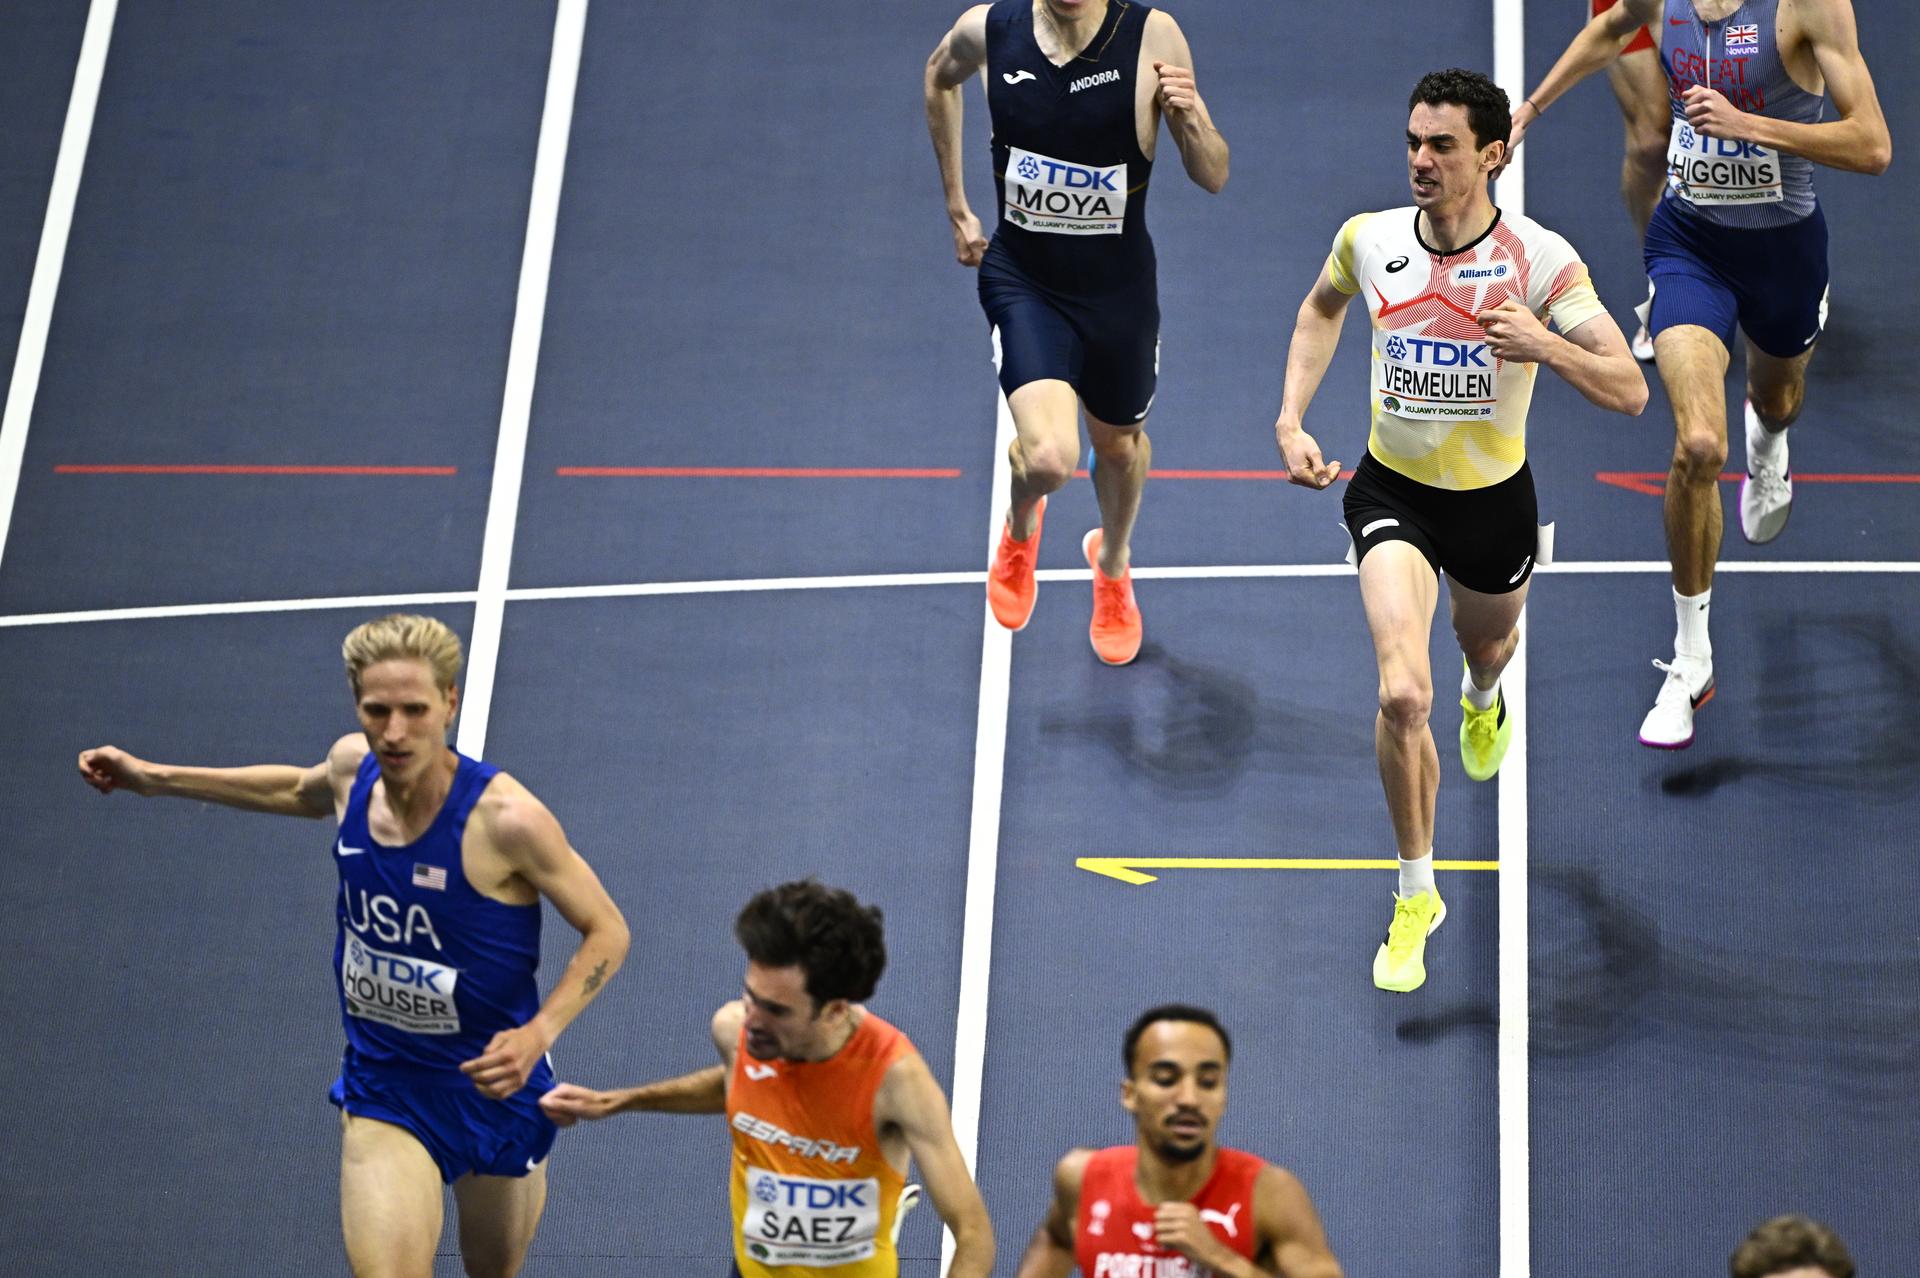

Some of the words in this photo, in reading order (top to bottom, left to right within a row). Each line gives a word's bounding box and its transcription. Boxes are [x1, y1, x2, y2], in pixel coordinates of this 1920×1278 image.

[1069, 69, 1121, 93] ANDORRA
[1671, 47, 1750, 85] GREAT
[1041, 160, 1118, 192] TDK
[1672, 154, 1774, 186] HIGGINS
[1016, 184, 1112, 216] MOYA
[1032, 220, 1066, 230] KUJAWY
[1458, 269, 1492, 279] Allianz
[1406, 338, 1488, 368] TDK
[1384, 363, 1492, 398] VERMEULEN
[1404, 405, 1438, 414] KUJAWY
[1438, 408, 1478, 416] POMORZE
[1480, 407, 1491, 415] 26
[344, 879, 442, 951] USA
[364, 949, 443, 995] TDK
[346, 963, 449, 1017] HOUSER
[779, 1180, 867, 1209] TDK
[760, 1211, 857, 1243] SAEZ
